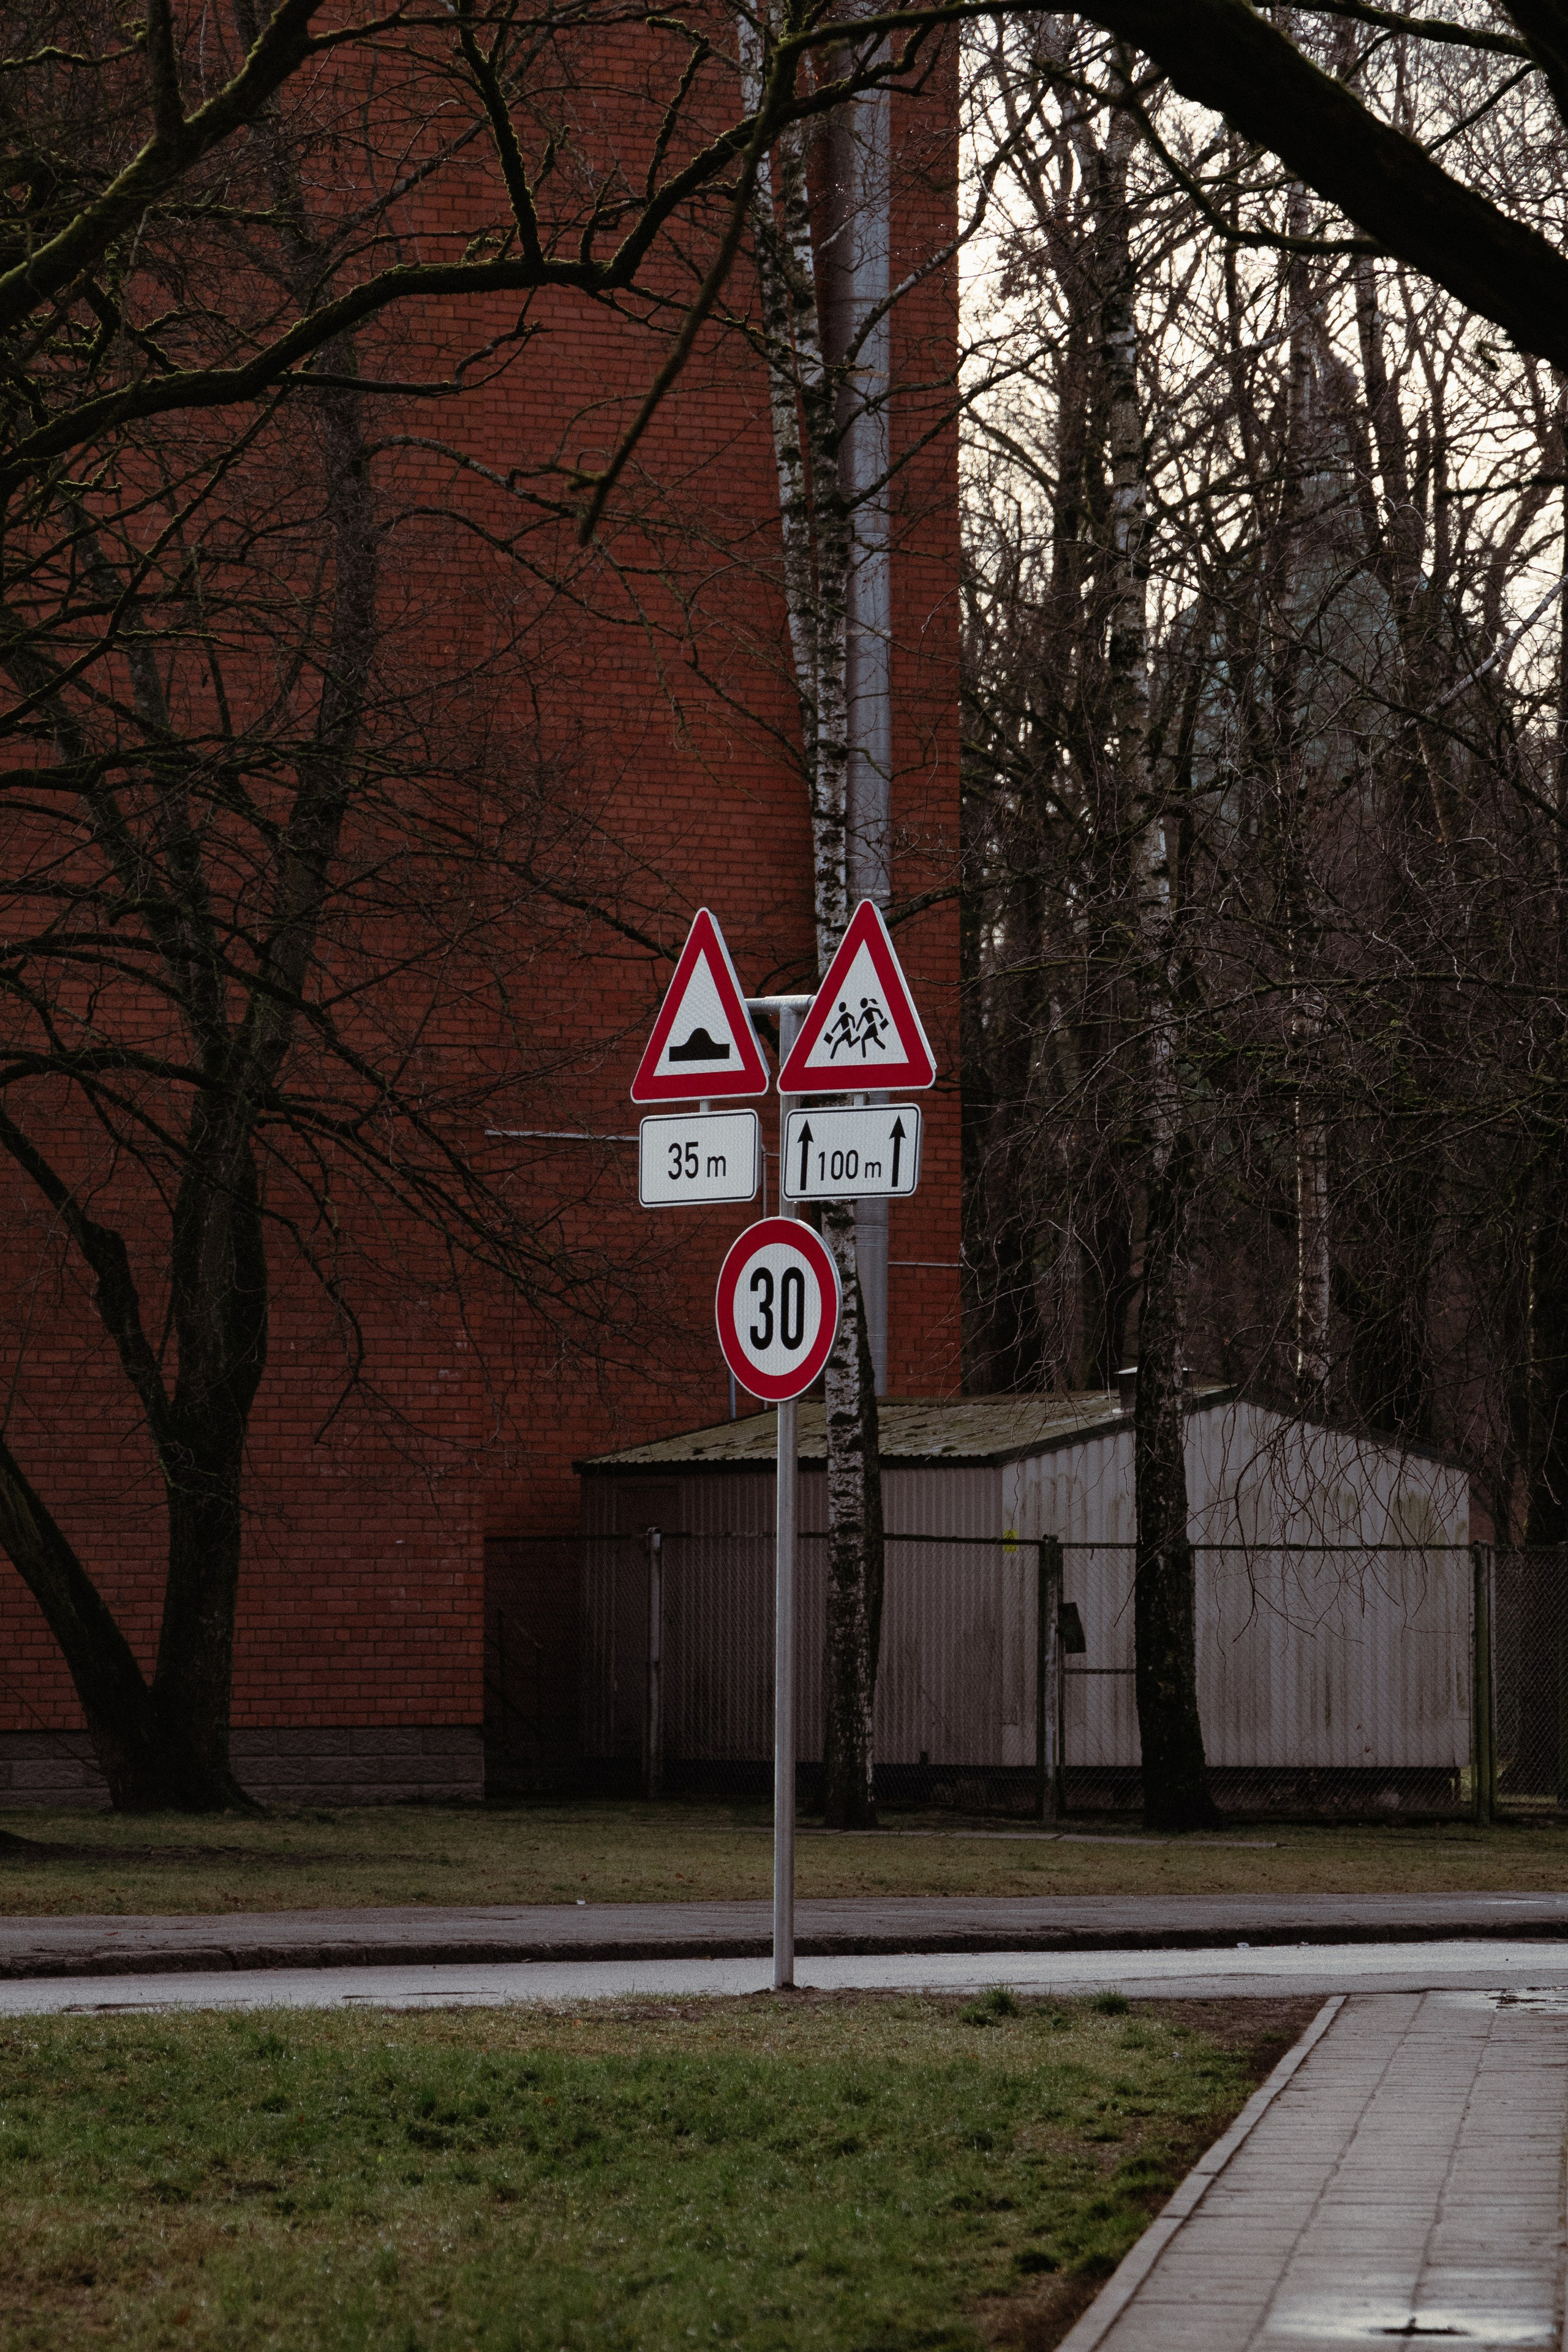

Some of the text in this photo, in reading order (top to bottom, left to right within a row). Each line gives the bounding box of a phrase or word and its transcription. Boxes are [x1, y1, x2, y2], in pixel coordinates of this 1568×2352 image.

[668, 1141, 726, 1180] 35 m
[818, 1149, 881, 1181] 100 m
[750, 1267, 805, 1350] 30
